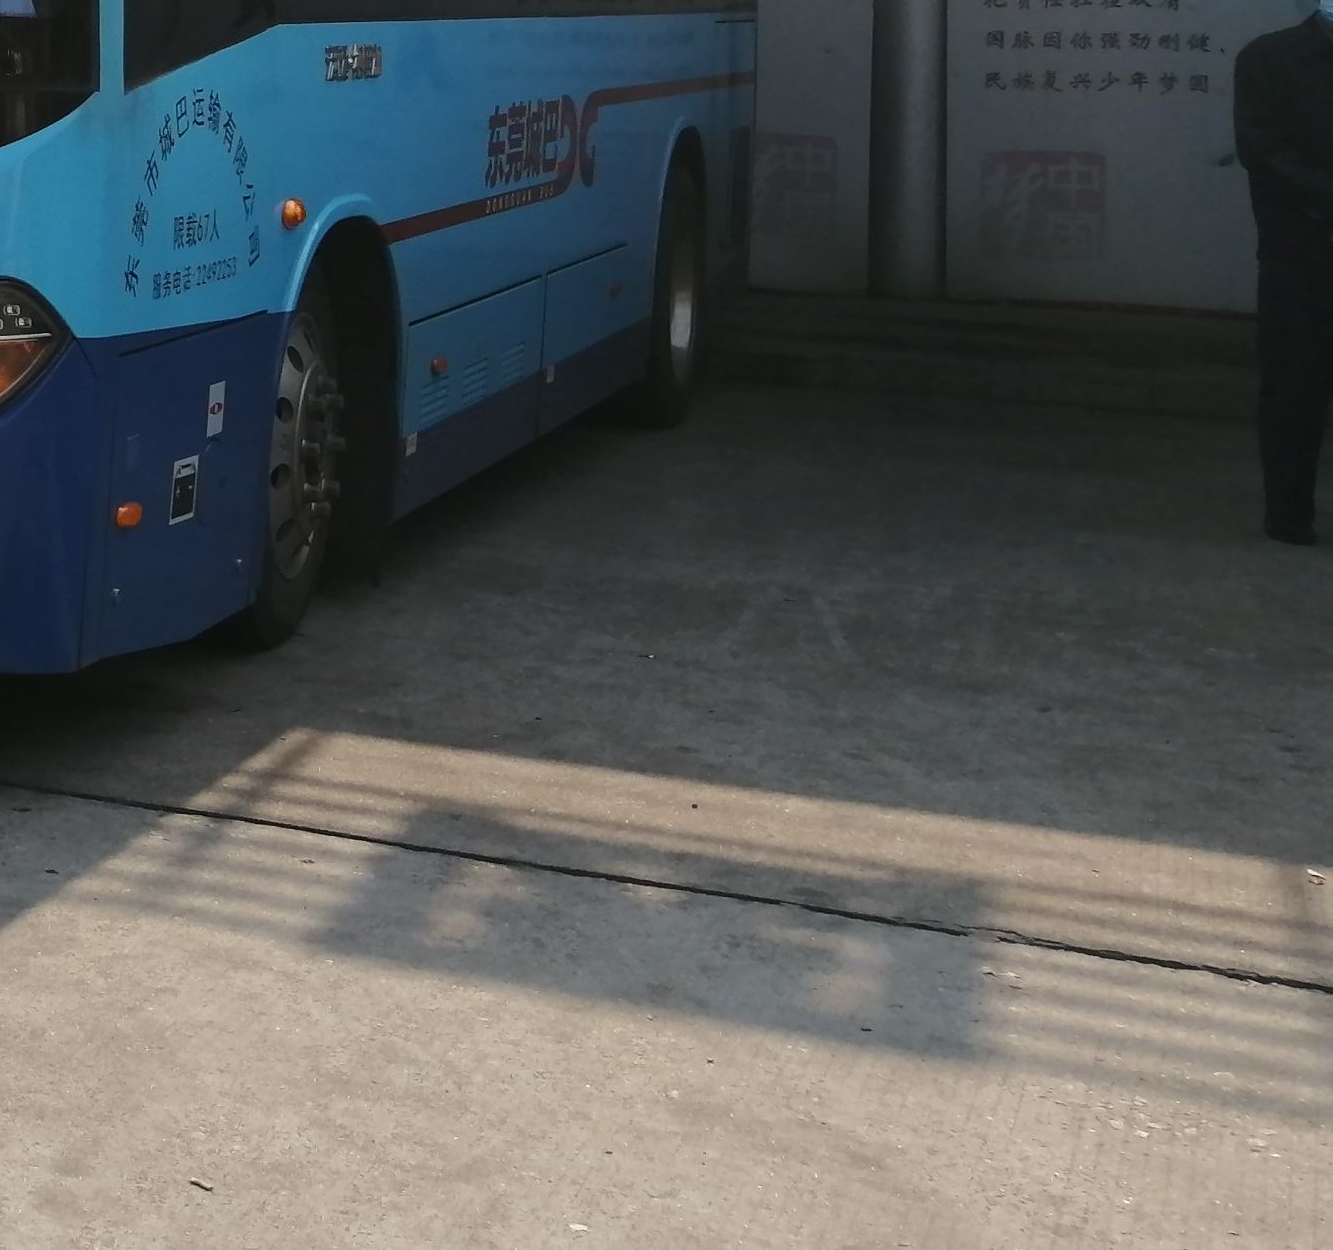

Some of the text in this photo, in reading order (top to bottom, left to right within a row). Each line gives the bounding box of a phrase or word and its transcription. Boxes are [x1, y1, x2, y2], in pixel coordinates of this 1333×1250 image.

[124, 87, 261, 298] 东莞市城巴运输有限公司
[172, 209, 221, 251] 限载67人
